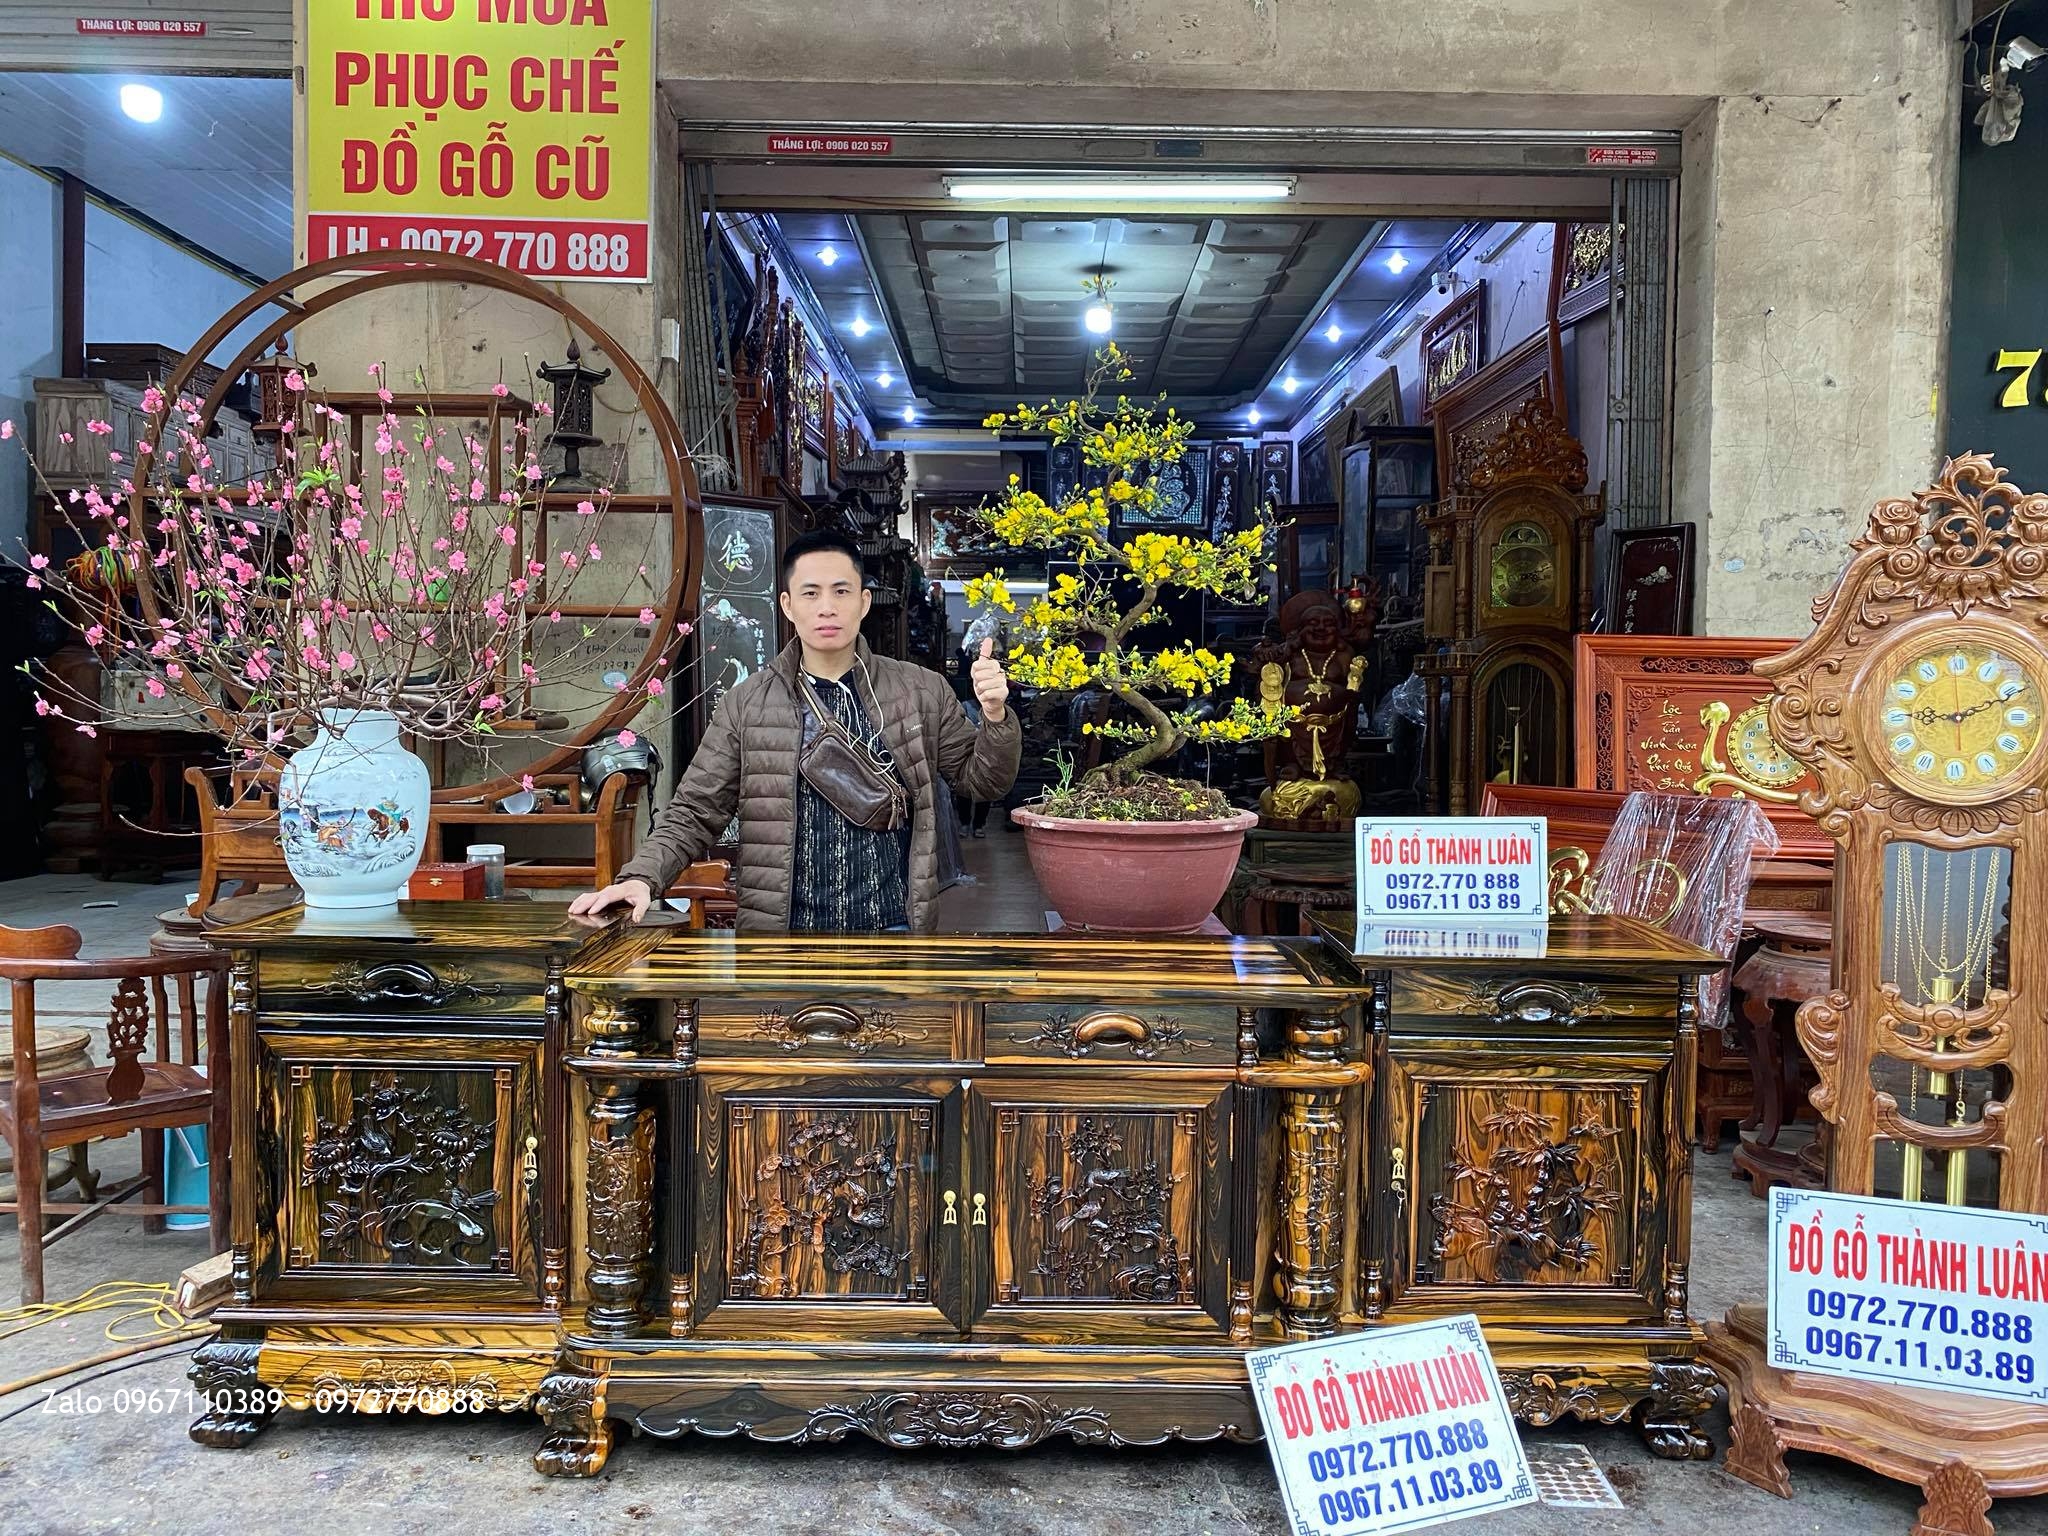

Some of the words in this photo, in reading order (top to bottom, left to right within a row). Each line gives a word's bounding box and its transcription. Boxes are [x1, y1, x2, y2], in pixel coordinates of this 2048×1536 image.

[137, 21, 160, 31] 0906
[163, 22, 181, 31] 020
[184, 23, 201, 32] 557
[335, 51, 488, 121] PHỤC
[510, 39, 626, 114] CHẾ
[341, 121, 418, 195] ĐỒ
[439, 121, 514, 198] GỖ
[535, 134, 610, 200] CŨ
[826, 140, 849, 150] 0906
[851, 141, 869, 151] 020
[871, 141, 889, 151] 557
[567, 233, 629, 273] 888
[1996, 348, 2048, 407] 7
[1427, 833, 1482, 865] THÀNH
[1488, 833, 1532, 865] LUÂN
[1386, 873, 1477, 890] 0972.770
[1484, 873, 1520, 889] 888
[1386, 893, 1459, 910] 0967.11
[1468, 893, 1491, 909] 03
[1497, 893, 1521, 909] 89
[1789, 1209, 1824, 1276] ĐỒ
[1834, 1213, 1868, 1281] GỖ
[1877, 1228, 1967, 1293] THÀNH
[1977, 1240, 2048, 1303] LUÂN
[1808, 1288, 2033, 1344] 0972.770.888
[1806, 1326, 2035, 1384] 0967.11.03.89
[1312, 1358, 1350, 1433] GỖ
[1346, 1360, 1430, 1425] THÀNH
[1422, 1345, 1490, 1410] LUÂN
[1308, 1418, 1488, 1483] 0972.770.888
[1319, 1458, 1503, 1526] 0967.11.03.89
